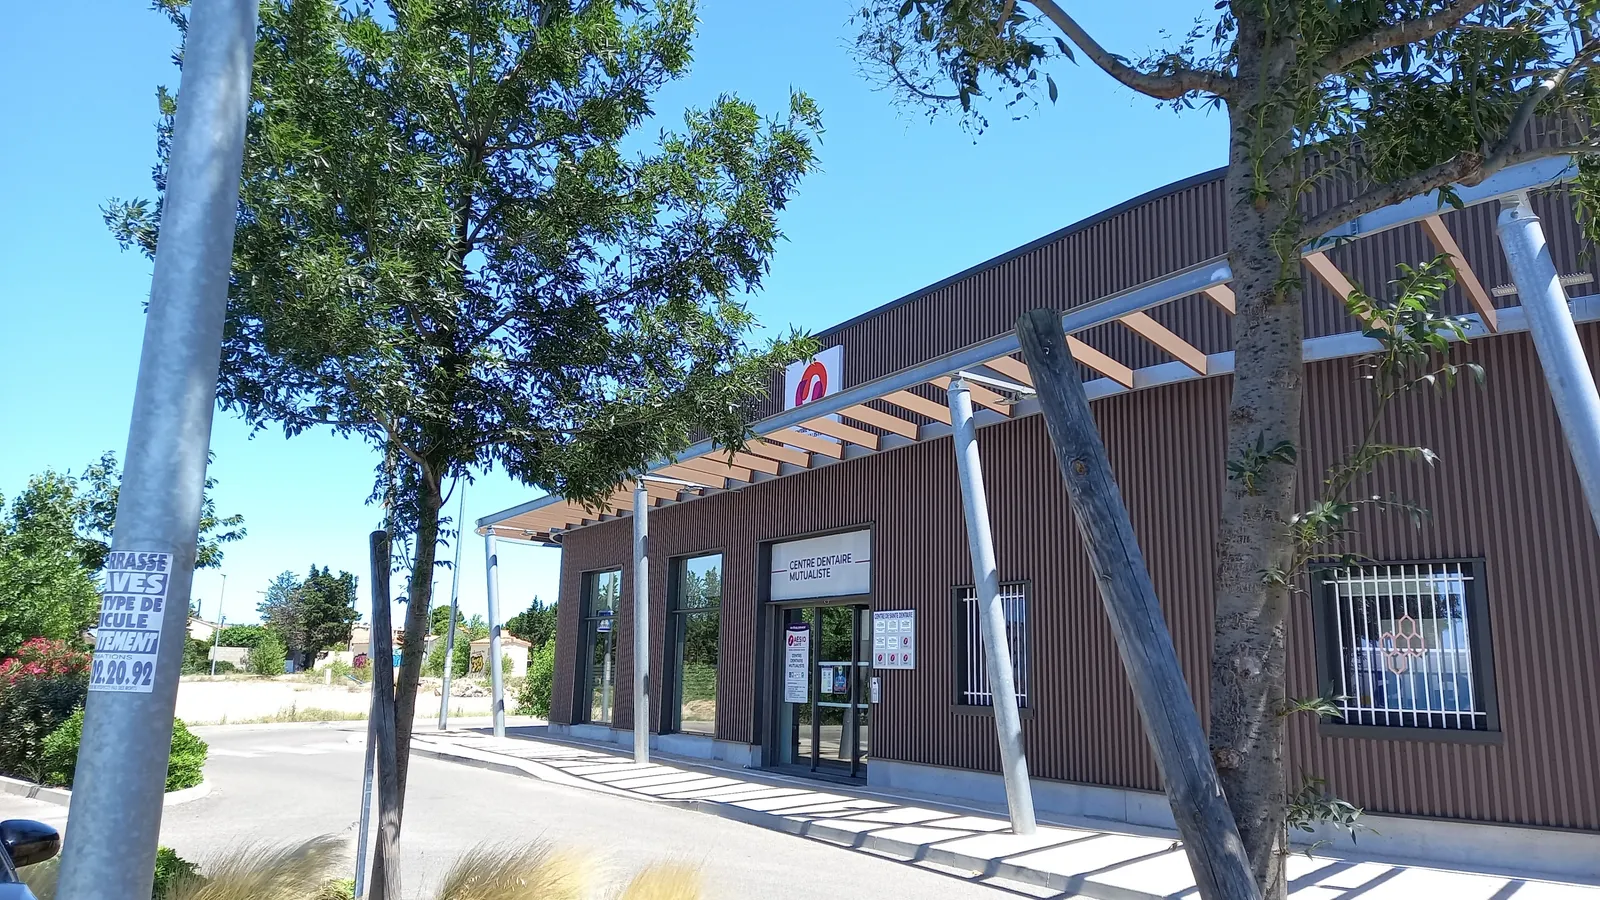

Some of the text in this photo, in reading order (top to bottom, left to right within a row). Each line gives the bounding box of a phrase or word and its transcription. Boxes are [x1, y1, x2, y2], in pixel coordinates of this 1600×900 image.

[789, 553, 852, 570] CENTRE DENTAIRE
[789, 568, 831, 581] MUTUALISTE
[103, 596, 163, 613] TYPE DE
